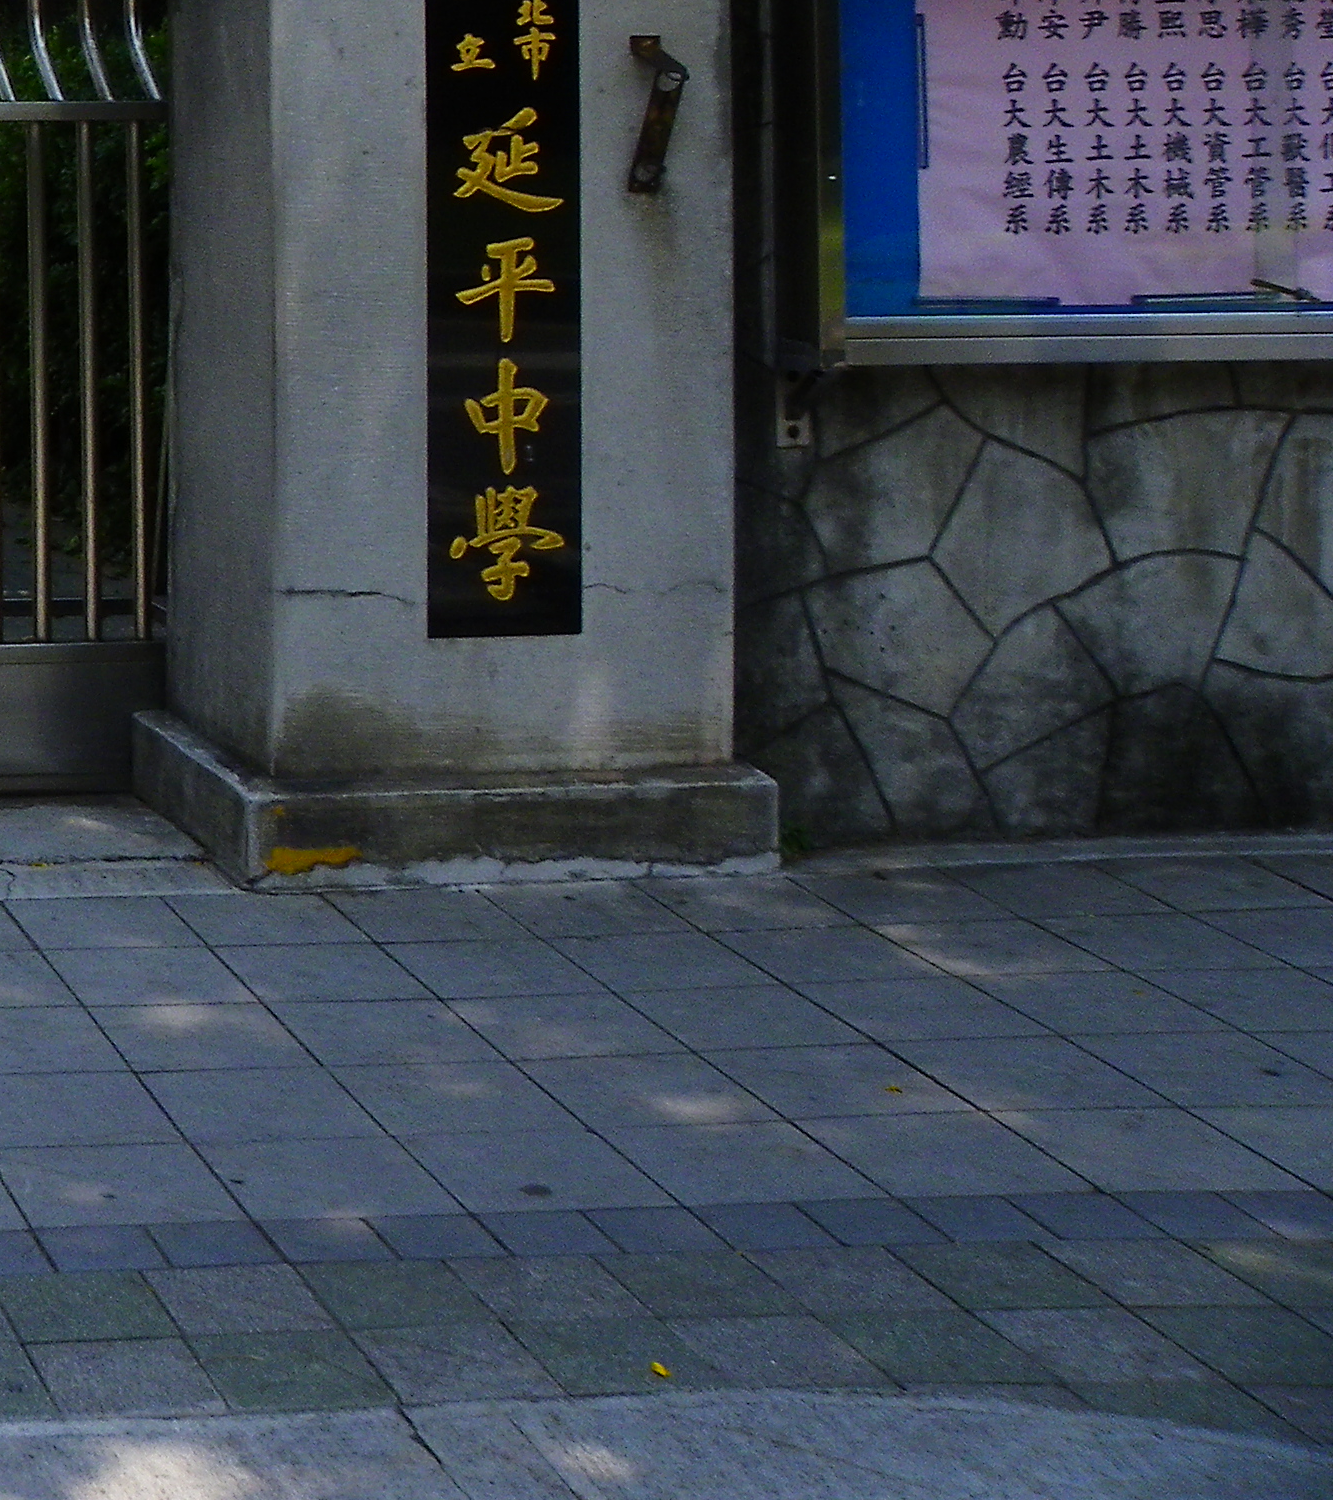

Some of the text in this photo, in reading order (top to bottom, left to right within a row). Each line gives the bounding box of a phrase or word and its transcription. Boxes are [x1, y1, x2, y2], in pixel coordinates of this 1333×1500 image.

[1001, 62, 1035, 235] 台大農經系
[1041, 62, 1075, 235] 台大生傳系
[1084, 61, 1116, 235] 台大土木系
[1124, 61, 1155, 234] 台大土木系
[1161, 61, 1195, 234] 台大機械系
[1200, 61, 1233, 234] 台大資管系
[1241, 61, 1273, 234] 台大工管系
[1281, 61, 1311, 233] 台大獸醫系
[448, 106, 565, 602] 延平中學
